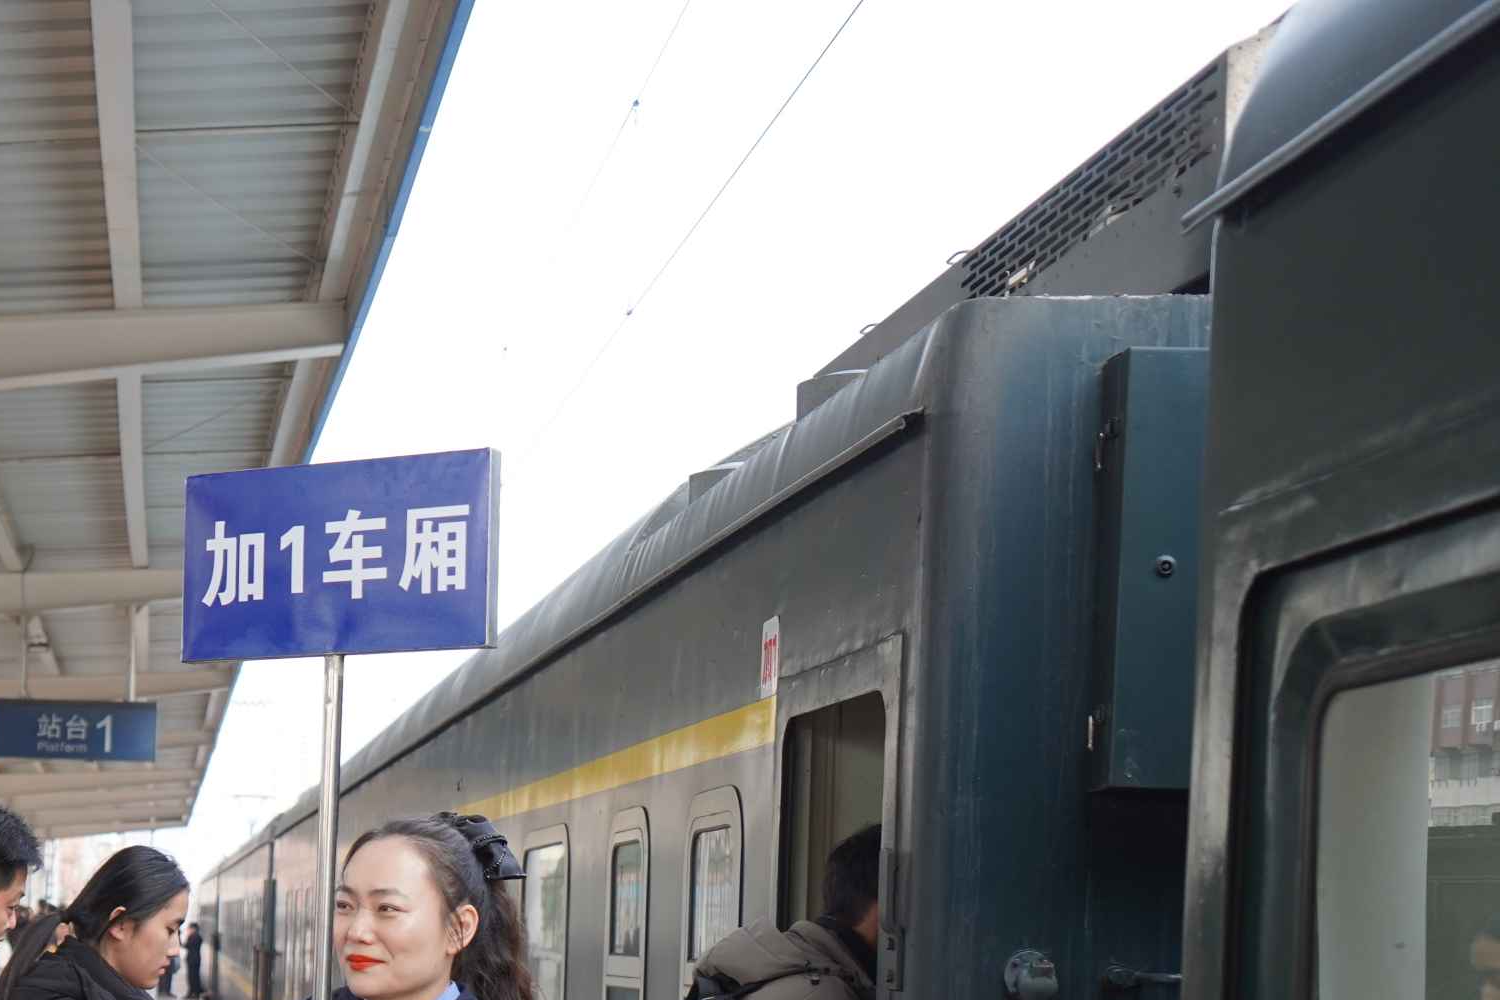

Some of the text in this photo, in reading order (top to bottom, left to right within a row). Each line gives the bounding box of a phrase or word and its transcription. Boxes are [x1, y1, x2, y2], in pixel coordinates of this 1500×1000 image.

[202, 504, 470, 607] 加1车厢
[37, 740, 88, 753] Platform
